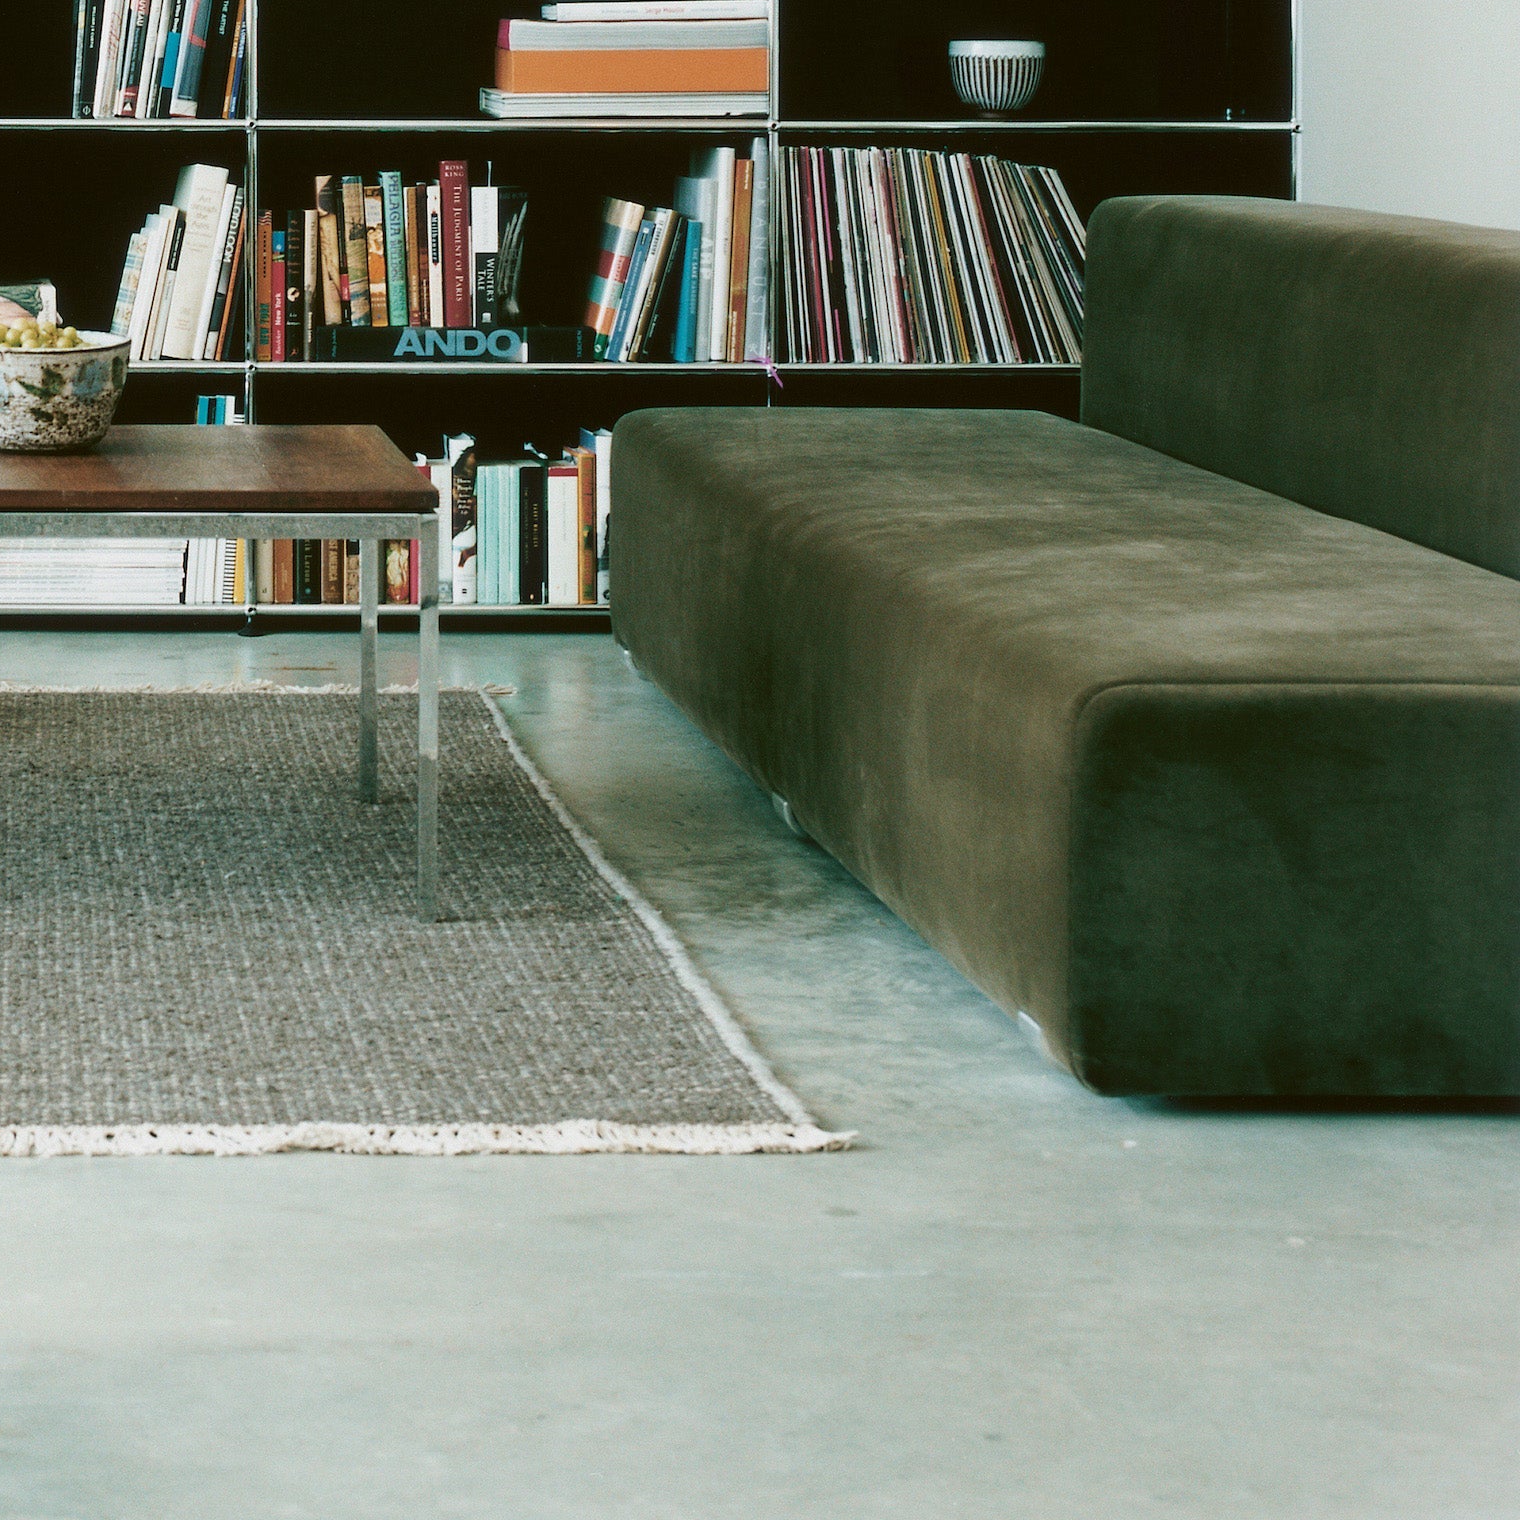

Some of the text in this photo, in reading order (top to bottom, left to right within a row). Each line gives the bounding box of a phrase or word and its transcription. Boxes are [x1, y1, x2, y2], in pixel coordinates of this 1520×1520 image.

[218, 1, 229, 36] THE ARTIST
[444, 163, 464, 171] ROSS
[444, 170, 465, 178] KING
[388, 174, 402, 237] PELAGIA
[222, 187, 244, 264] LLOYD LOOM
[430, 216, 440, 262] Millhauser
[453, 184, 465, 303] THE JUDGMENT OF PARIS
[700, 237, 714, 280] ARP
[476, 270, 487, 292] TALE
[485, 258, 496, 304] WINTER'S
[690, 261, 698, 278] SAKE
[260, 303, 271, 346] NEW YORK
[274, 292, 283, 327] New York
[392, 327, 521, 357] ANDO
[303, 554, 312, 583] Larson
[327, 551, 339, 582] AMERICA
